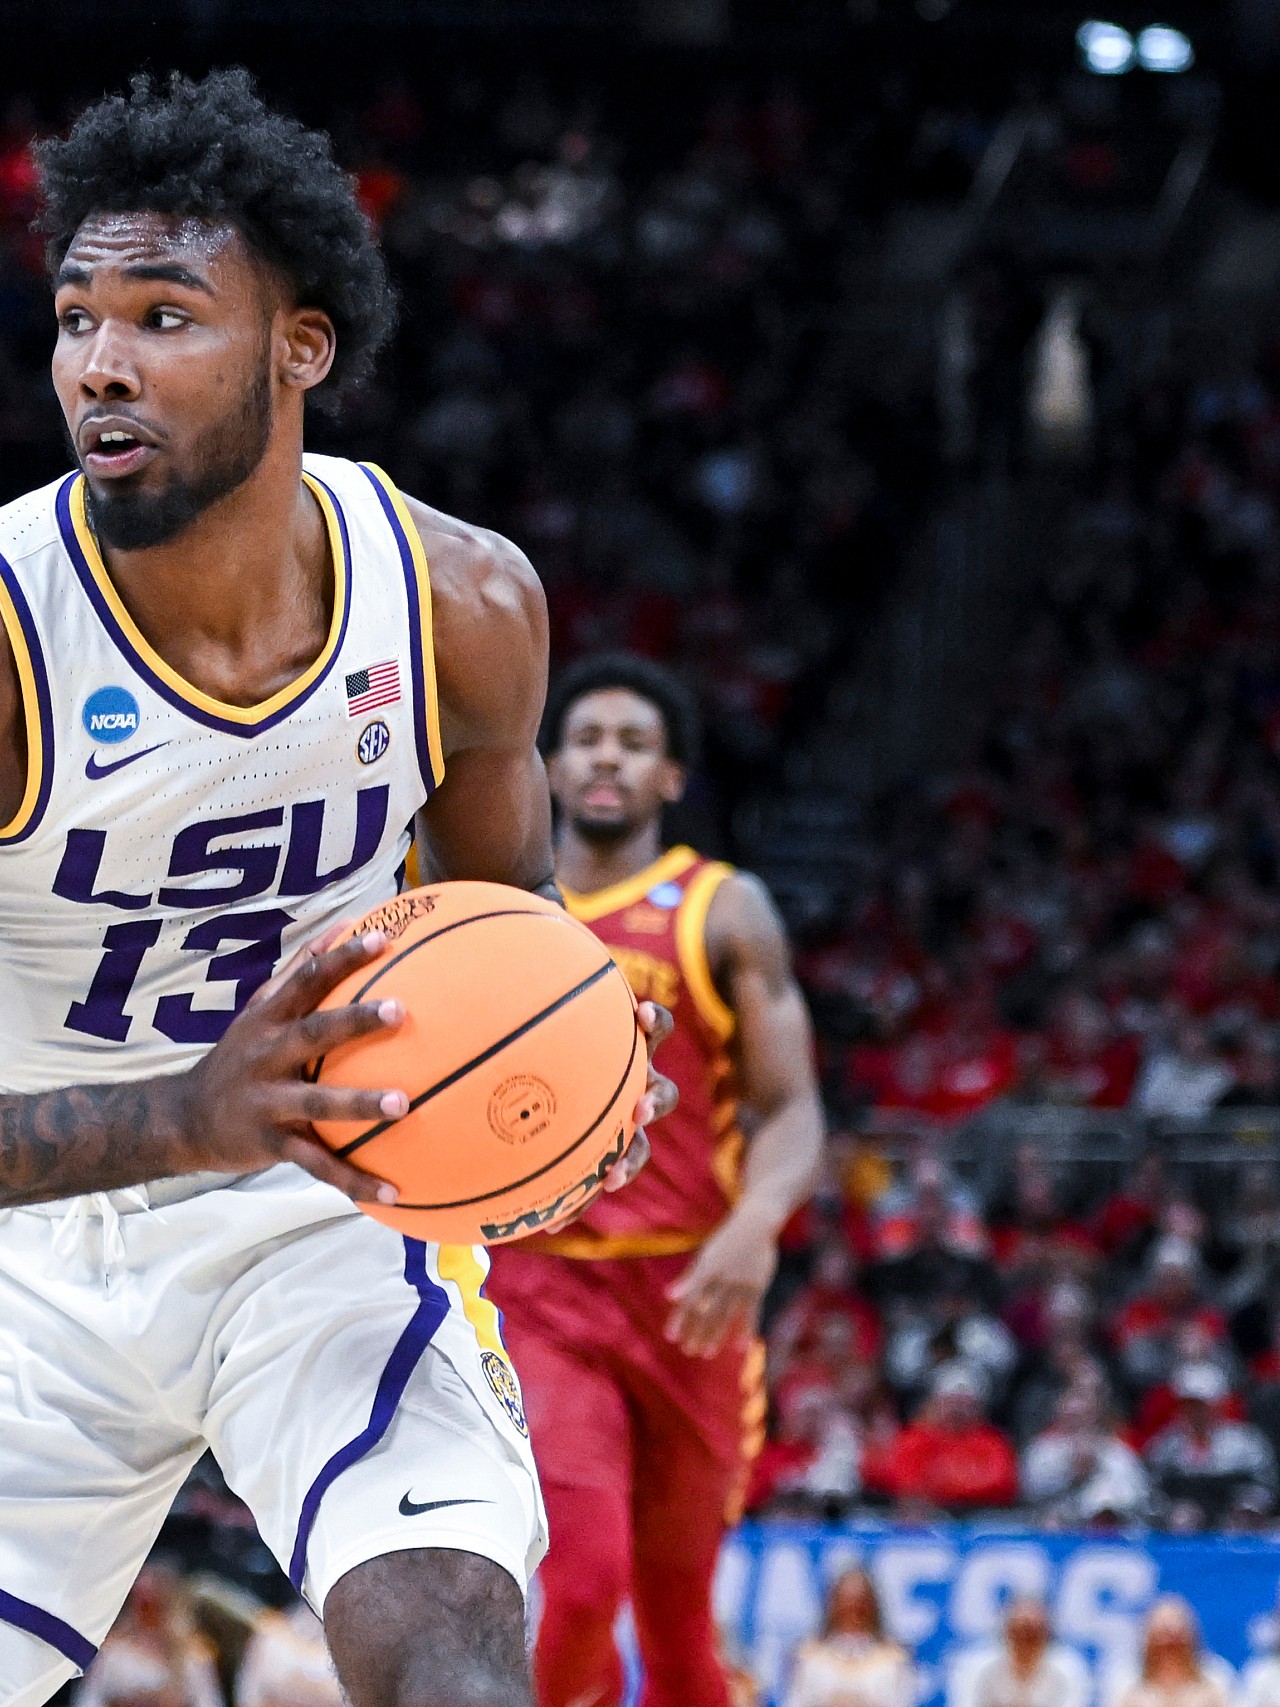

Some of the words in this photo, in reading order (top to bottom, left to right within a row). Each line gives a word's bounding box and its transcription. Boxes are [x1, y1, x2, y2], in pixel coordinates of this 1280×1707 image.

[90, 713, 136, 730] NCAA
[359, 723, 389, 763] SEC
[52, 784, 389, 909] LSU
[63, 908, 297, 1044] 13
